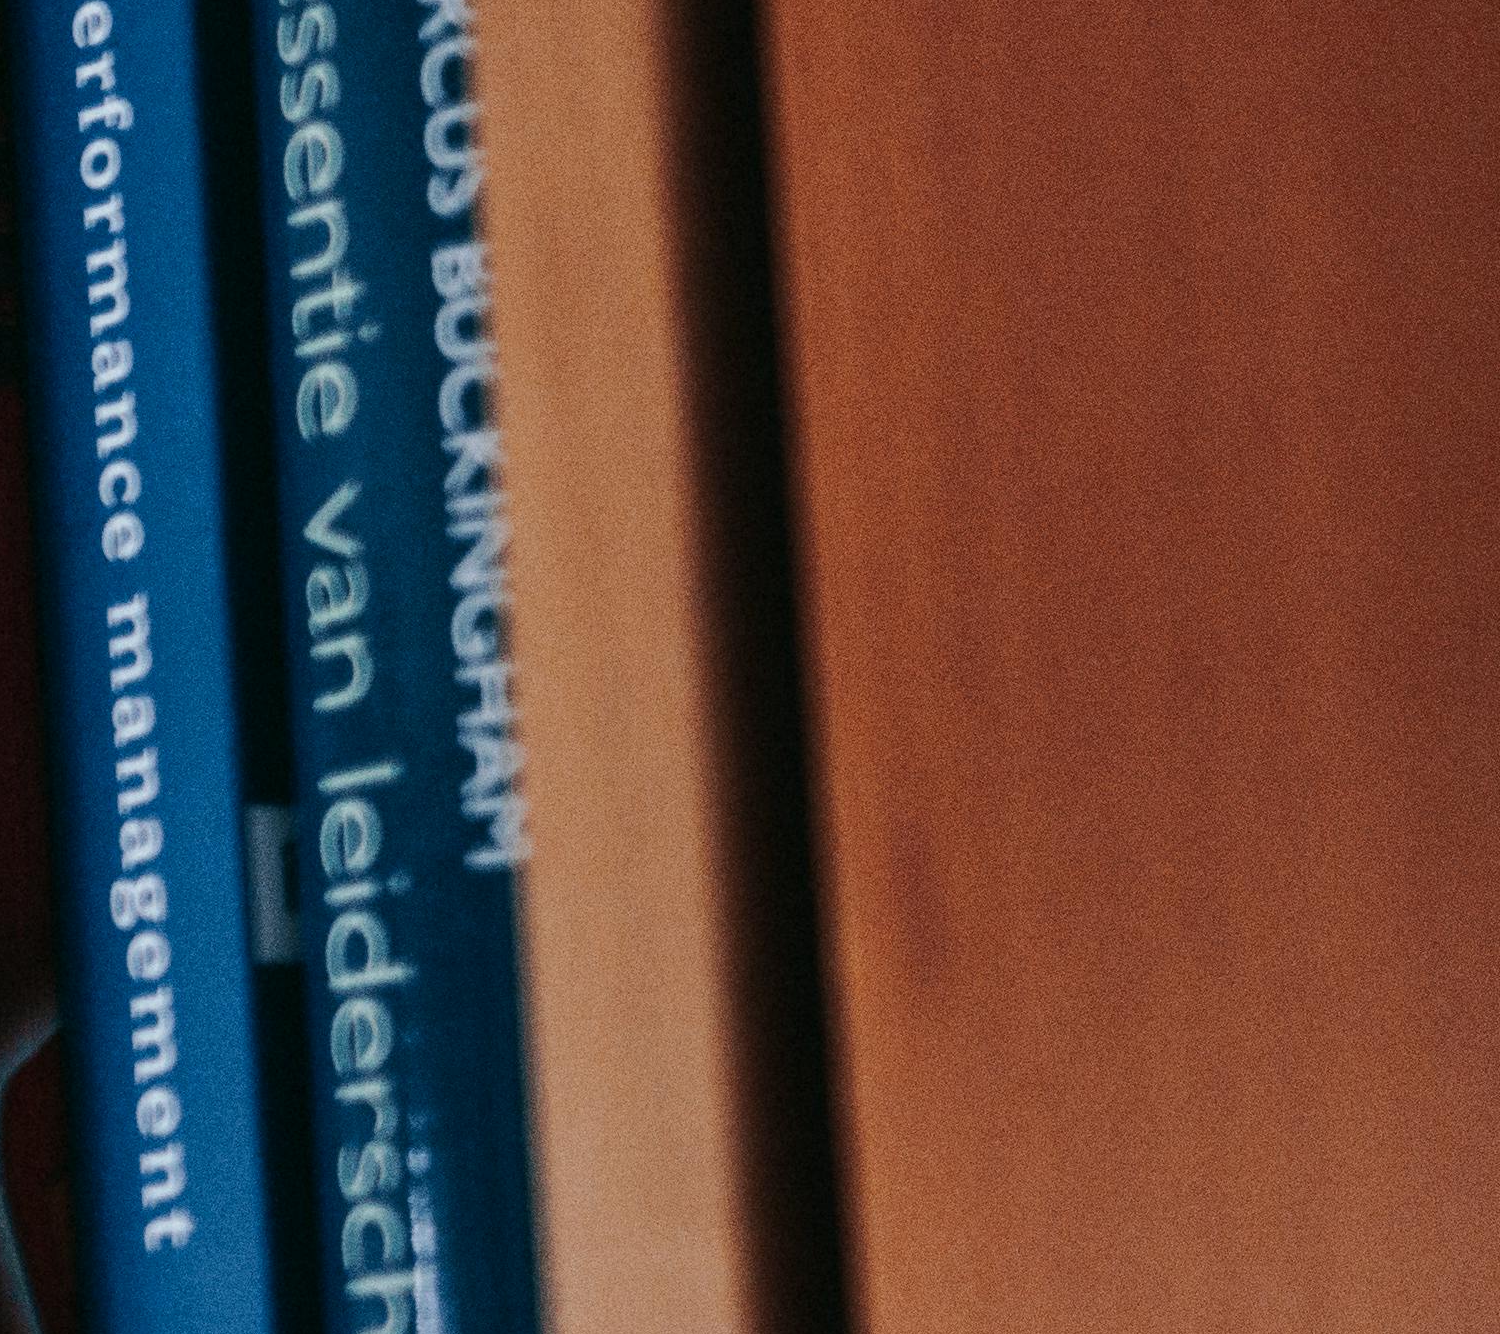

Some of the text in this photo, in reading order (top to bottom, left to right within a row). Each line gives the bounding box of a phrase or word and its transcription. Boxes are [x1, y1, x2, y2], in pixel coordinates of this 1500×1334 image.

[303, 477, 375, 714] van
[430, 240, 534, 871] BUCKINGHAM
[106, 590, 198, 1255] management
